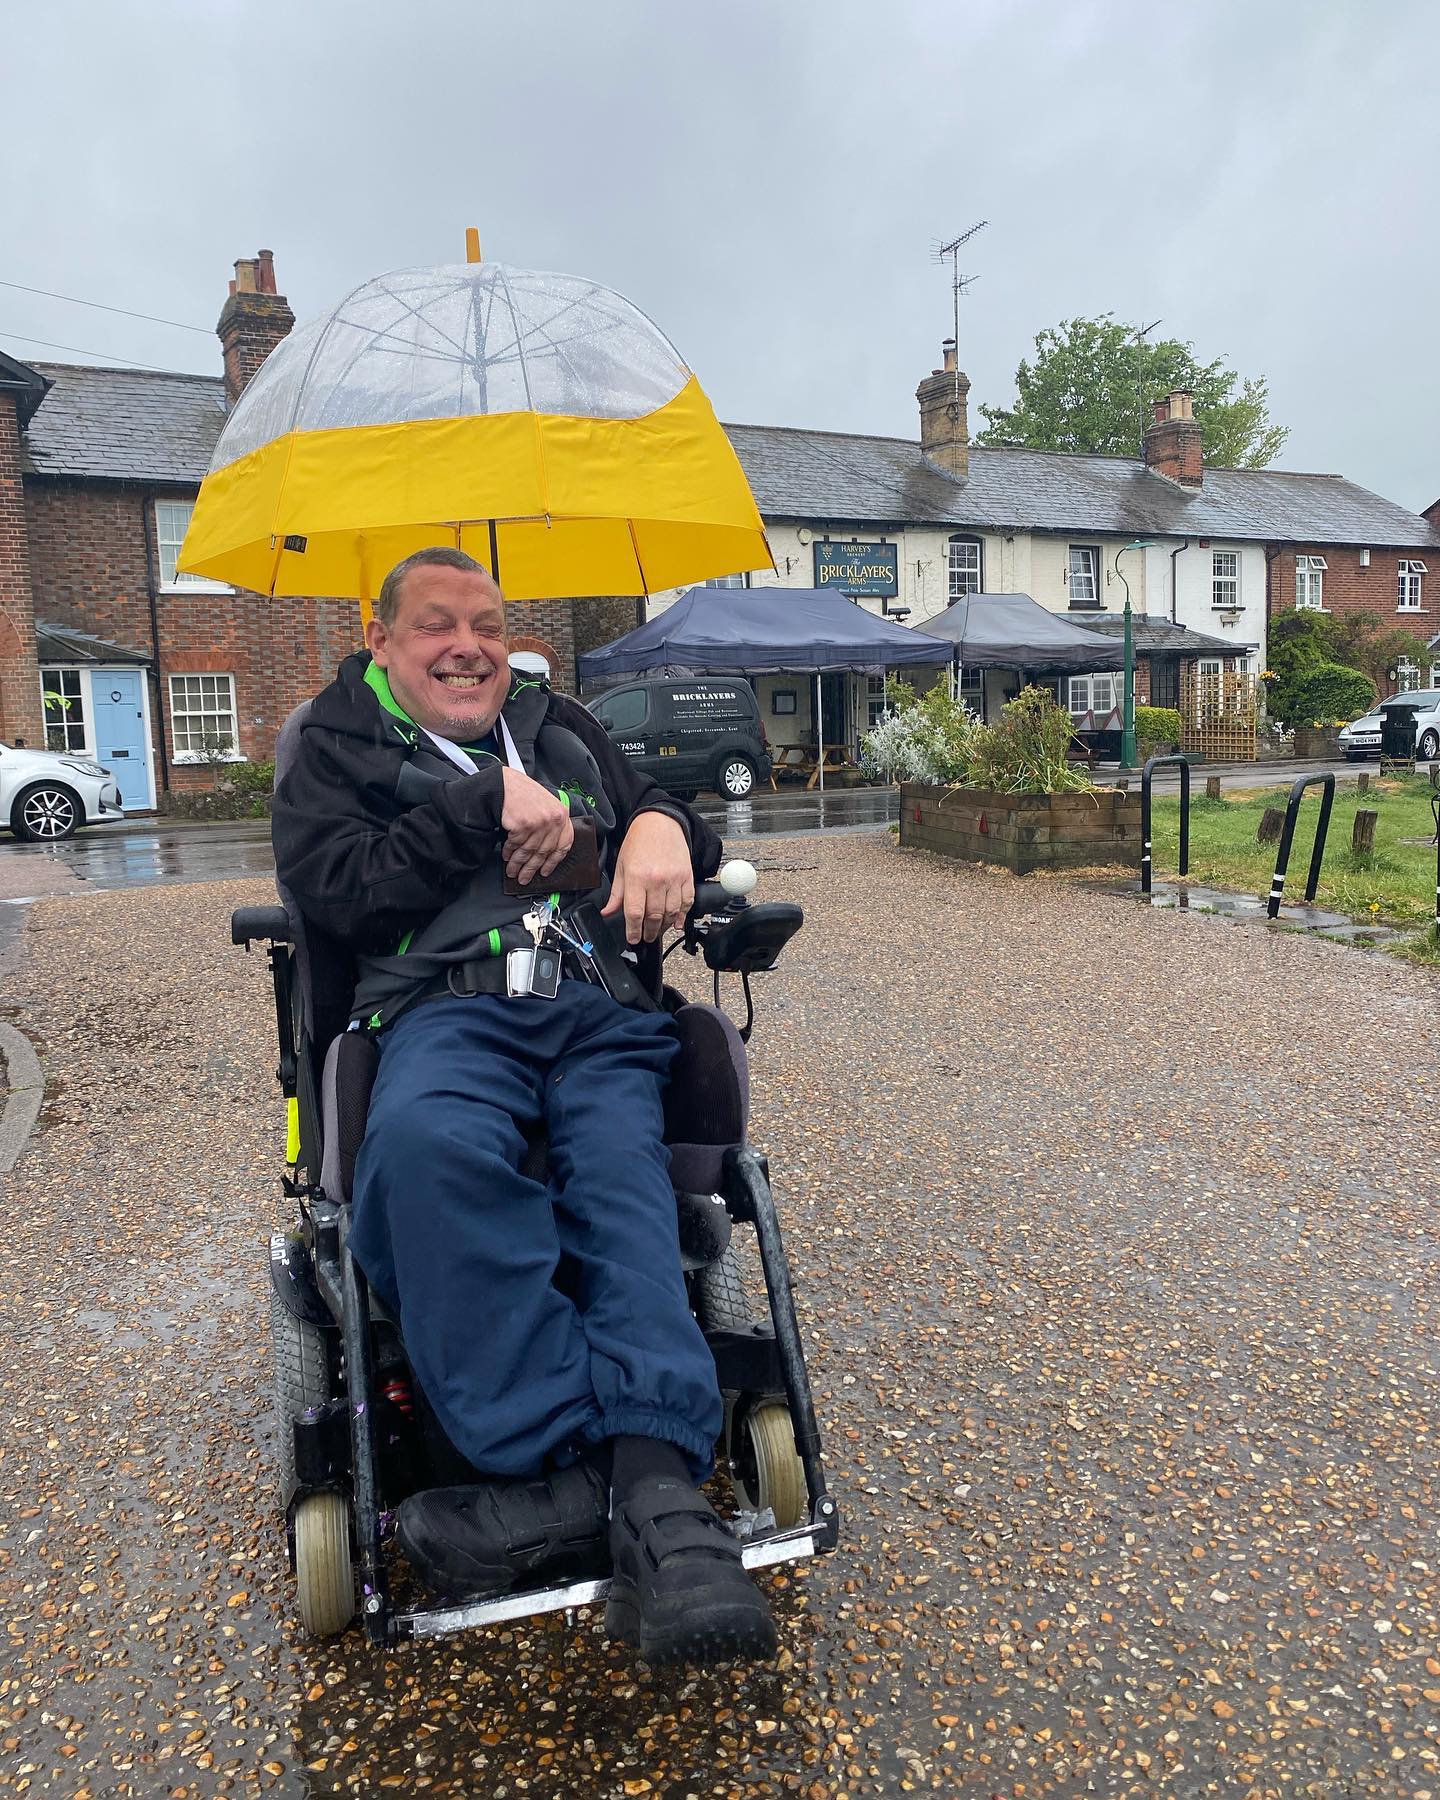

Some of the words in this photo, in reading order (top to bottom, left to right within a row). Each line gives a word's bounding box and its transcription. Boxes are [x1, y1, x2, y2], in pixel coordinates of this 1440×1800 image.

[841, 545, 871, 553] HARVEY'S
[820, 564, 894, 584] BRICKLAYERS
[847, 577, 867, 585] ARMS
[672, 692, 737, 701] BRICKLAYERS
[621, 742, 645, 751] 743424
